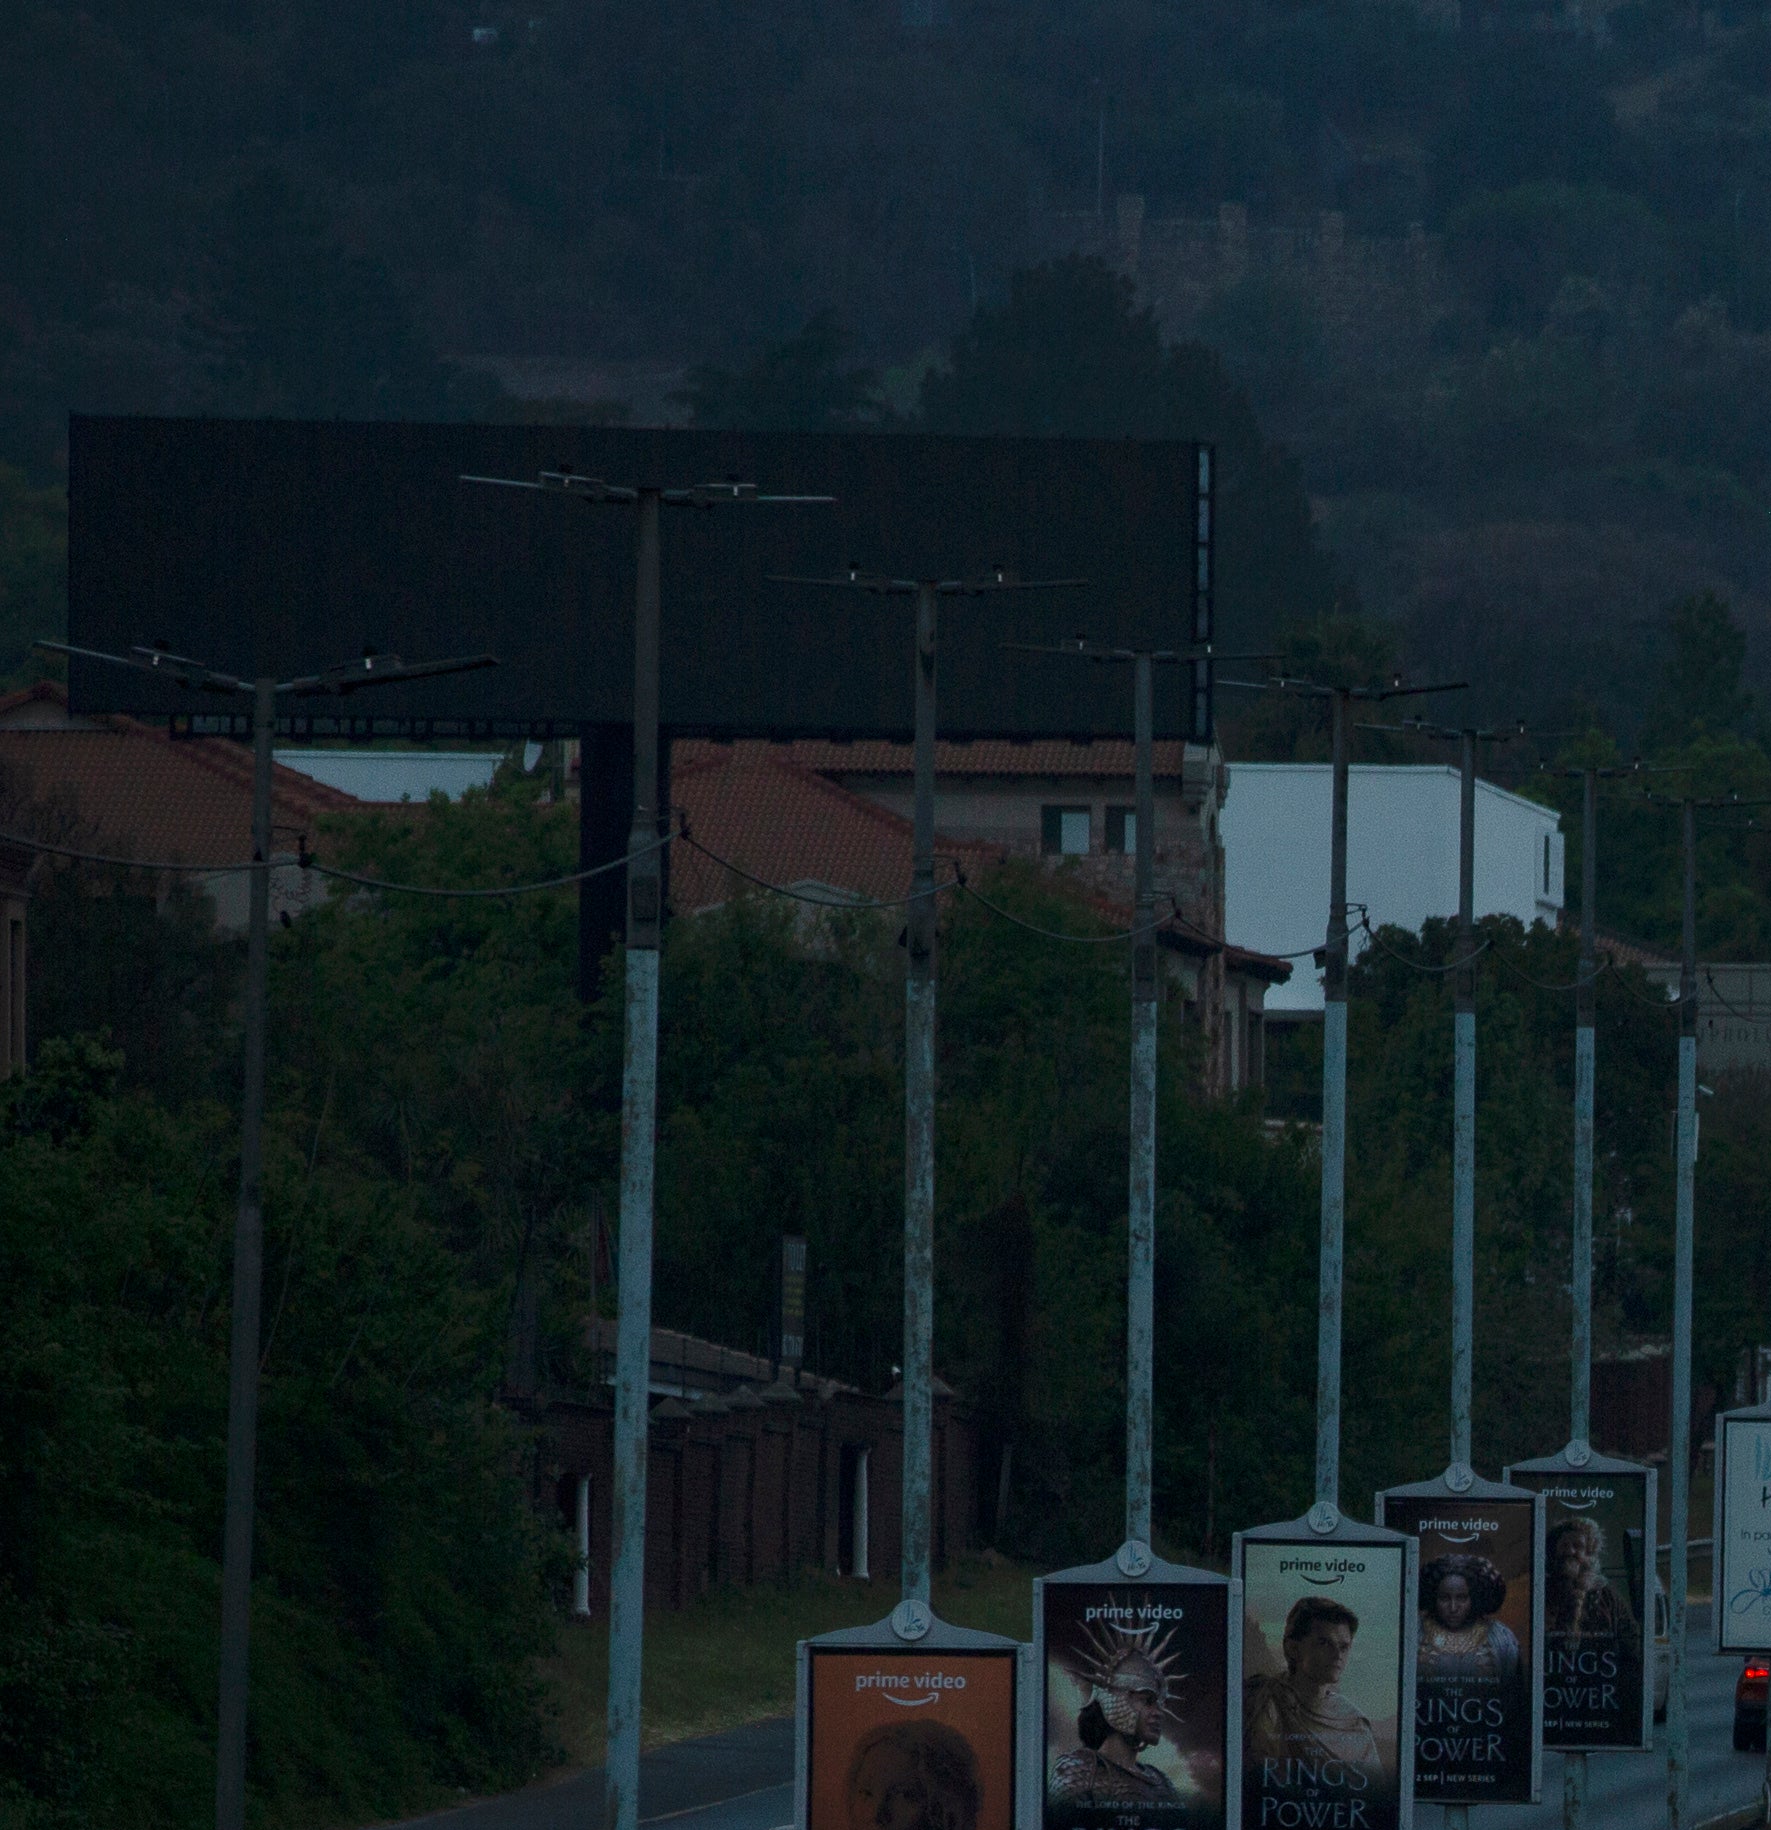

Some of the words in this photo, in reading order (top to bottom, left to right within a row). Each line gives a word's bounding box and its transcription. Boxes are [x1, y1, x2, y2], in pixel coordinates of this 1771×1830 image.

[1541, 1486, 1577, 1498] prime
[1580, 1486, 1615, 1499] video
[1418, 1516, 1458, 1533] prime
[1461, 1517, 1499, 1531] video
[1740, 1529, 1751, 1540] In
[1279, 1557, 1321, 1574] prime
[1325, 1558, 1366, 1573] video
[1085, 1603, 1133, 1622] prime
[1137, 1603, 1183, 1619] video
[1547, 1651, 1618, 1679] INGS
[855, 1671, 910, 1691] prime
[914, 1672, 966, 1689] video
[1544, 1684, 1620, 1709] OWER
[1446, 1725, 1460, 1734] OF
[1262, 1757, 1369, 1791] RINGS
[1423, 1774, 1438, 1782] SEP
[1446, 1774, 1465, 1782] NEW
[1467, 1774, 1496, 1783] SERIES
[1305, 1788, 1320, 1797] OF
[1096, 1800, 1119, 1809] LORD
[1121, 1800, 1134, 1809] OF
[1138, 1801, 1155, 1809] THE
[1261, 1796, 1371, 1829] POWER
[1116, 1815, 1141, 1826] THE
